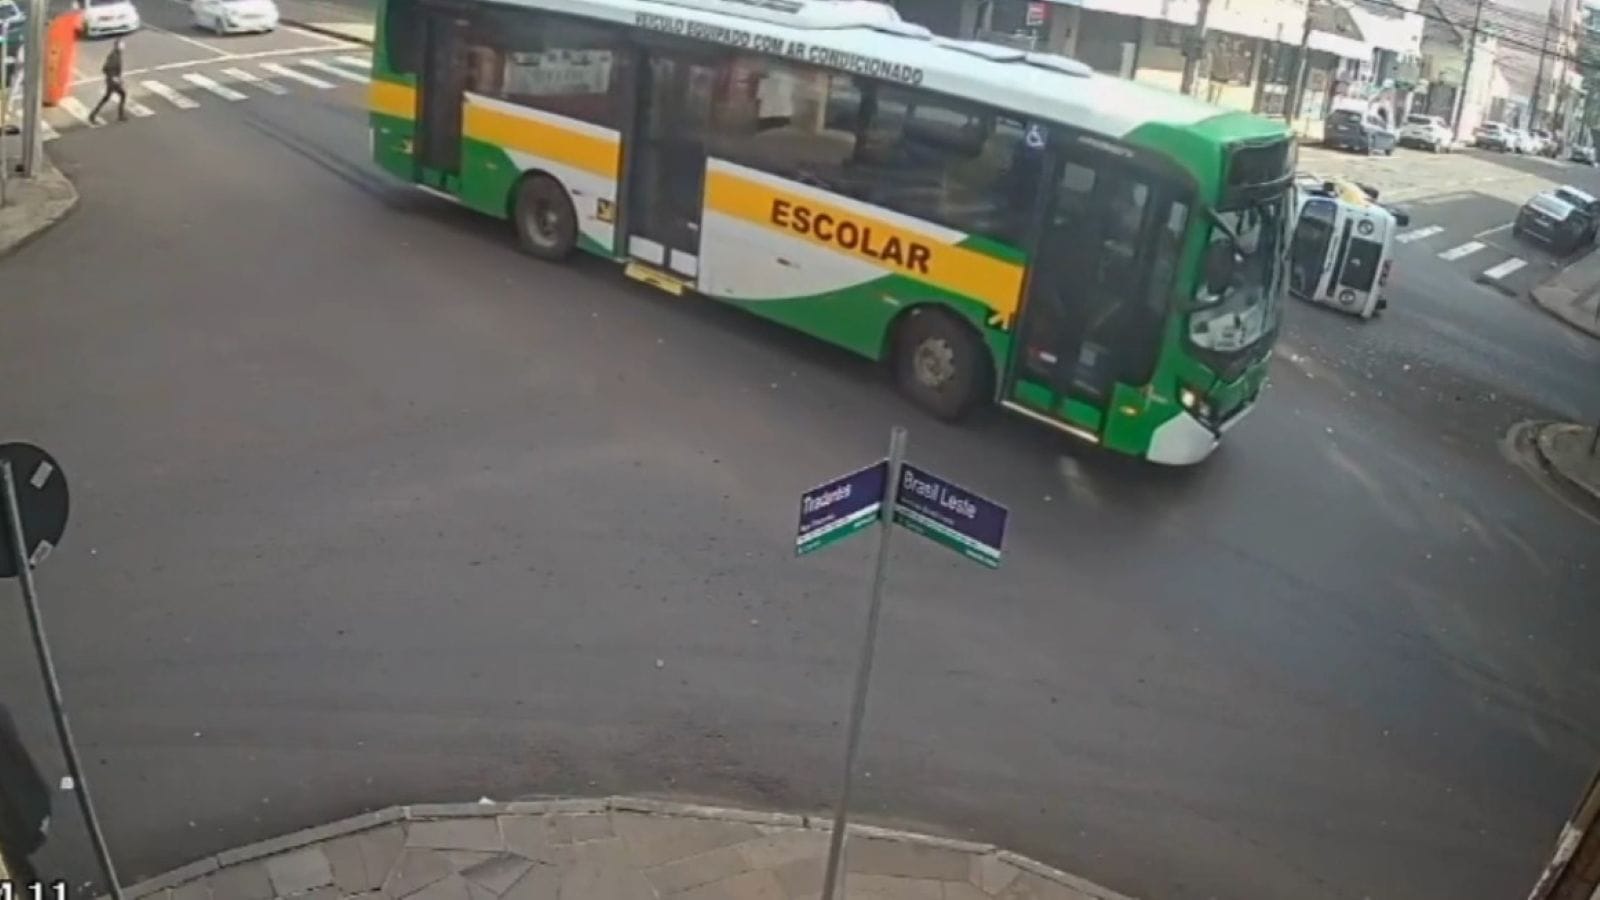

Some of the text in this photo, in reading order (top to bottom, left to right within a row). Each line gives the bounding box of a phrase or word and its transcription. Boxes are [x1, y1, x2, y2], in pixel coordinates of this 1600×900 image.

[687, 20, 750, 46] EQUIPADO
[754, 34, 784, 54] COM
[786, 41, 806, 58] AR
[809, 45, 924, 84] CONDICIONADO
[771, 198, 931, 274] ESCOLAR
[903, 470, 939, 501] Brasil
[940, 487, 977, 519] Leste
